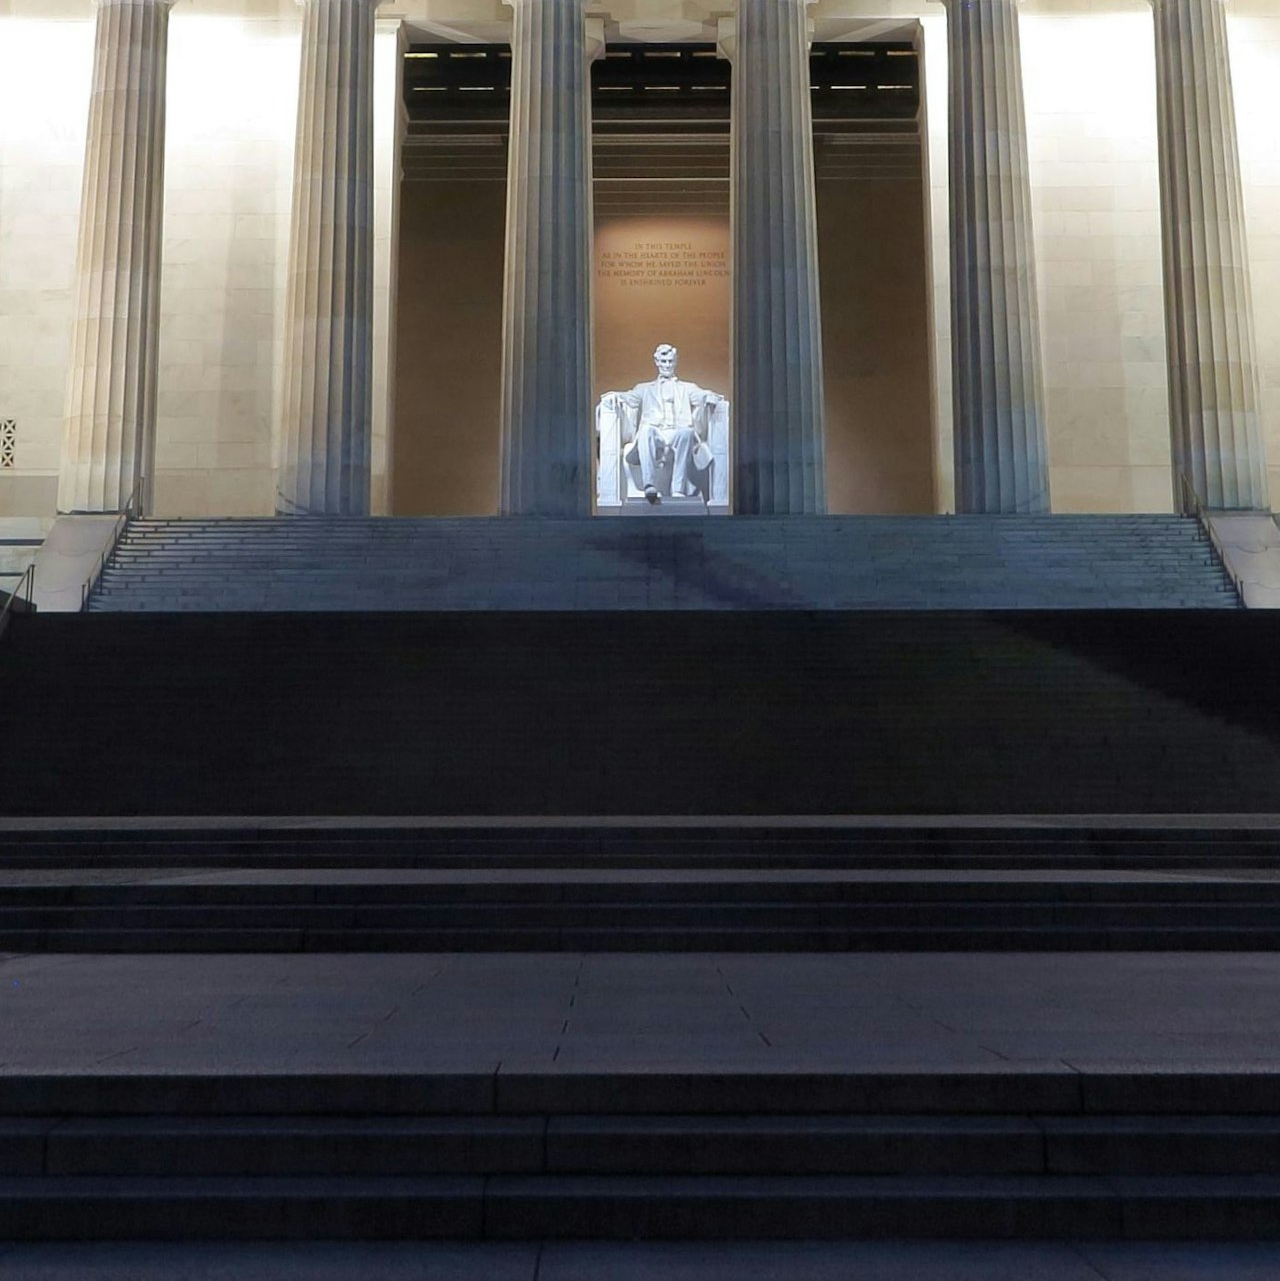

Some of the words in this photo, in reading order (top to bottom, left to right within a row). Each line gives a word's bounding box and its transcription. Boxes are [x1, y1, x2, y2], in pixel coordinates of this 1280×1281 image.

[635, 242, 643, 250] IN
[646, 242, 662, 250] THIS
[665, 242, 692, 250] TEMPLE
